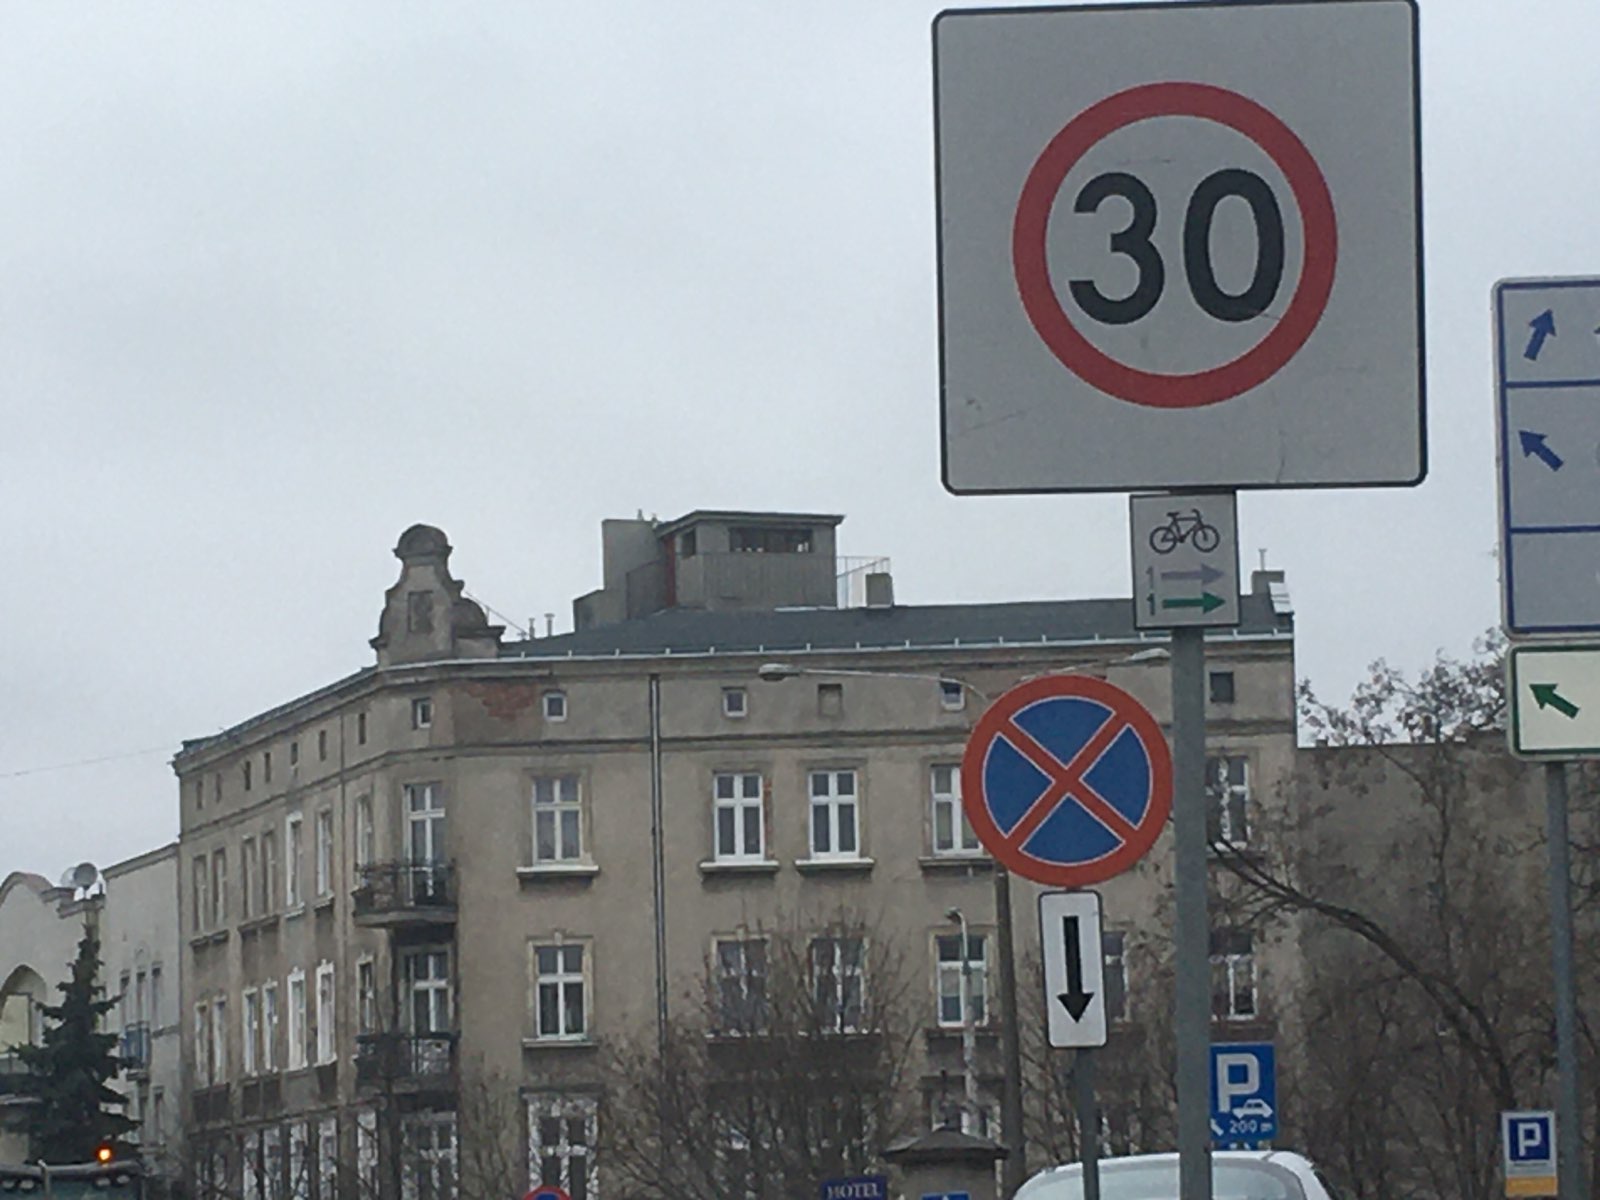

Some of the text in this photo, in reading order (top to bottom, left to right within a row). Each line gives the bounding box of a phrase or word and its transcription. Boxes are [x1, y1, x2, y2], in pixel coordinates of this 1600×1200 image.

[1068, 167, 1285, 325] 30
[1216, 1053, 1260, 1113] P
[1229, 1119, 1258, 1134] 200
[1518, 1122, 1541, 1157] P
[827, 1182, 882, 1199] HOTEL
